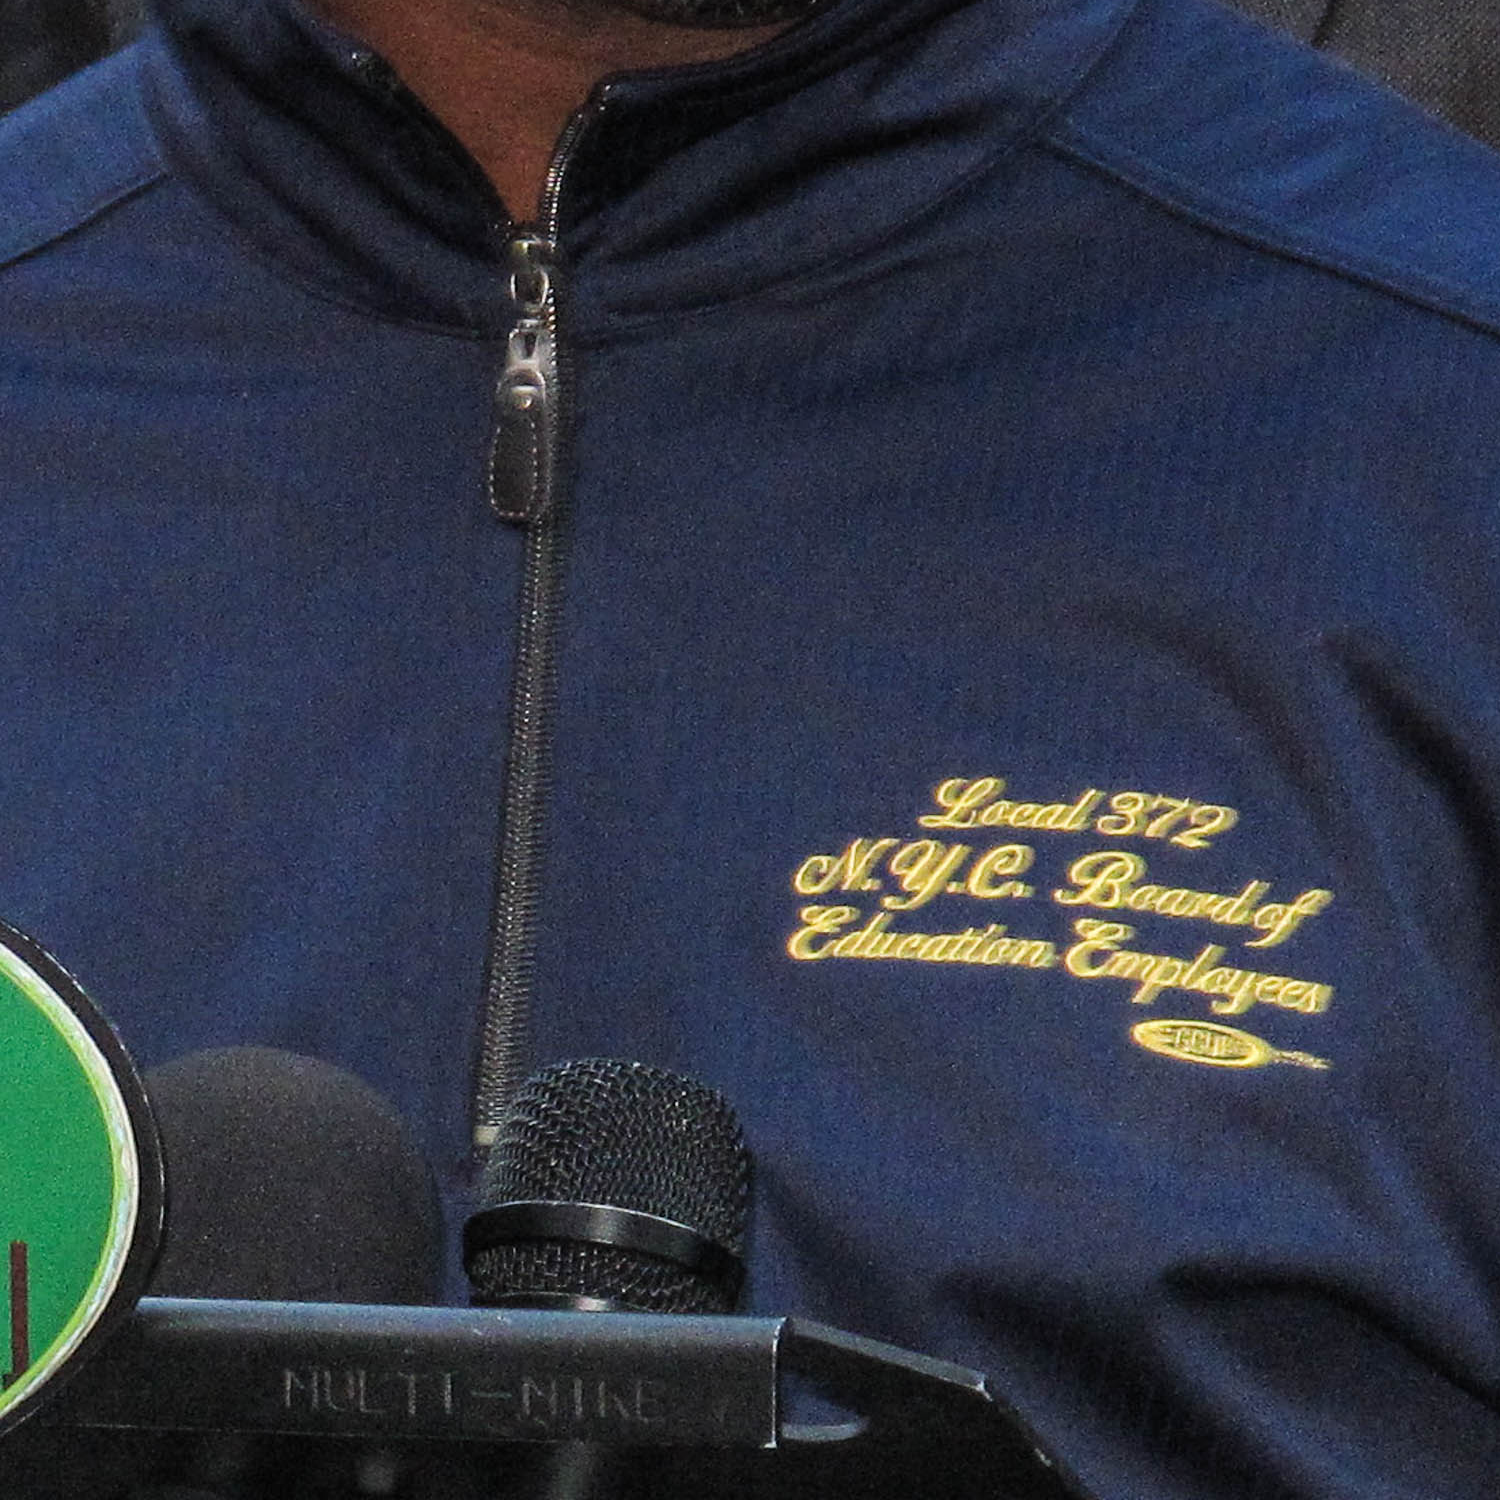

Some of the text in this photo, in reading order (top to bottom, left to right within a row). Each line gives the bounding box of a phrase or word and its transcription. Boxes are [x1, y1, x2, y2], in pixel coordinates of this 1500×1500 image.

[917, 776, 1239, 850] Local 372
[1053, 850, 1268, 926] Board
[1246, 888, 1335, 948] of
[787, 905, 1334, 1015] Education Employees
